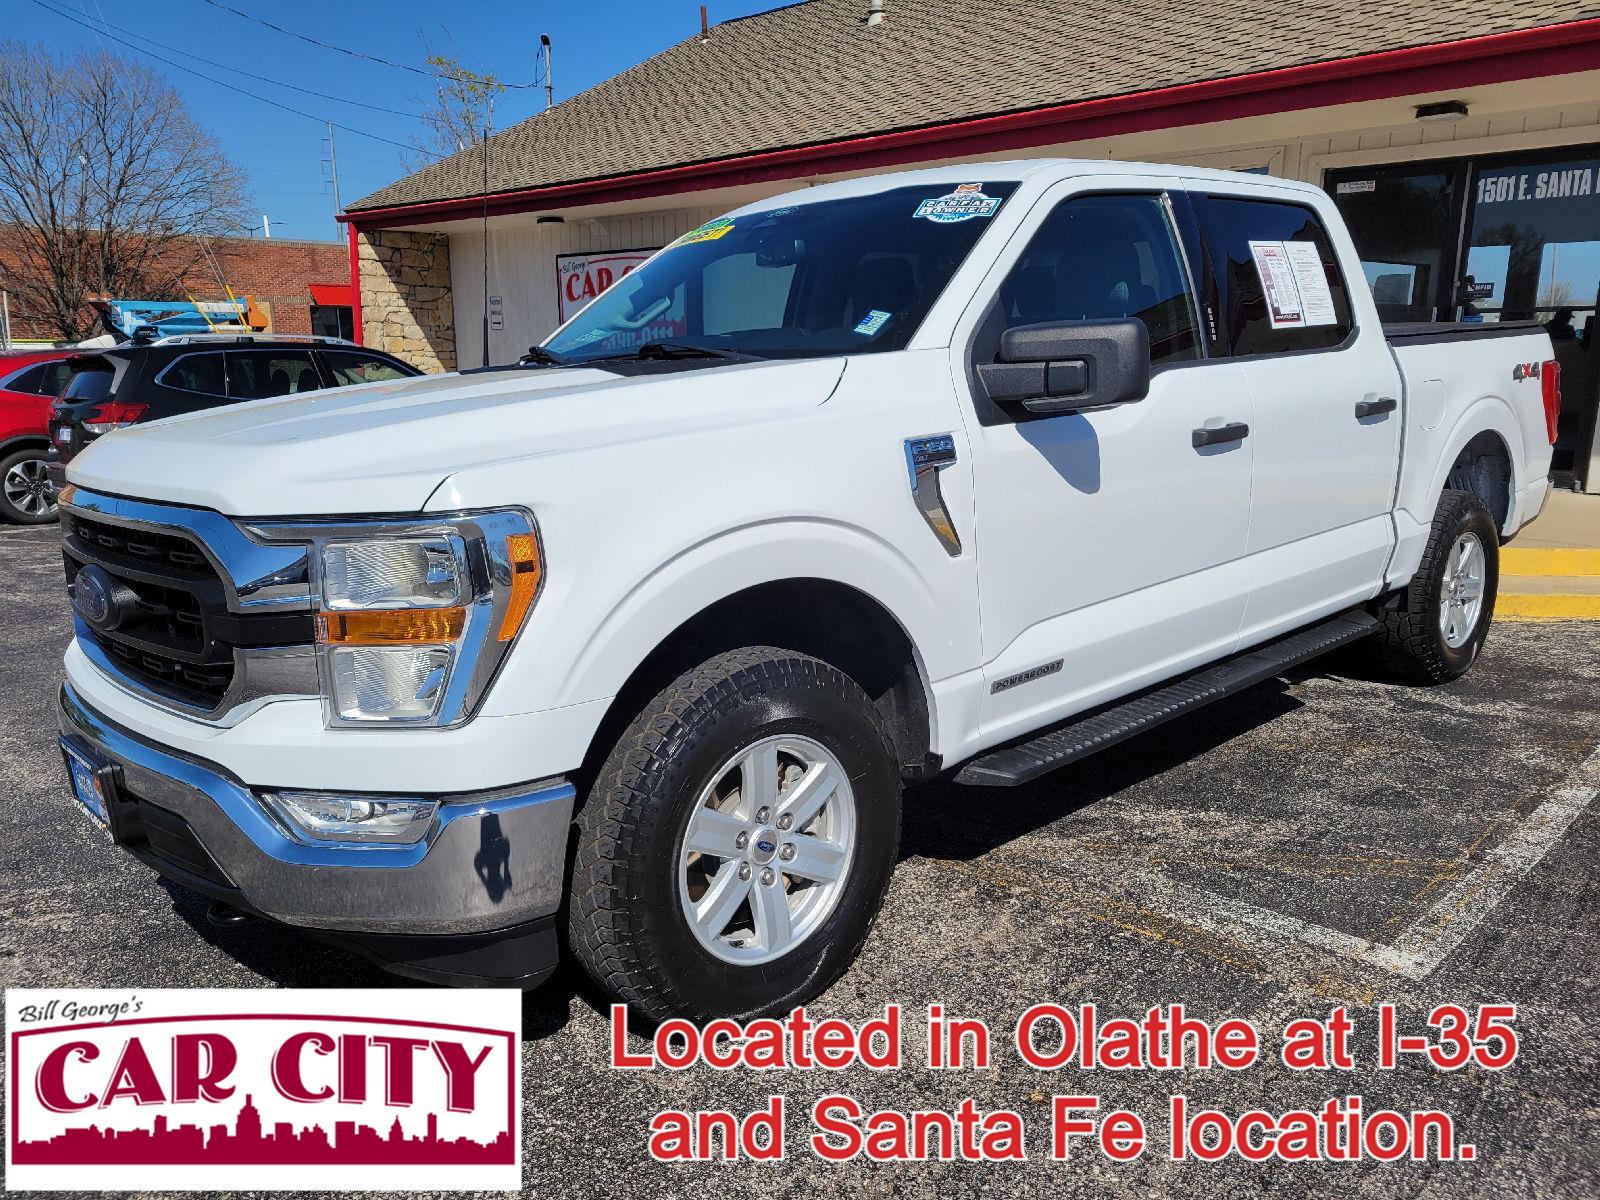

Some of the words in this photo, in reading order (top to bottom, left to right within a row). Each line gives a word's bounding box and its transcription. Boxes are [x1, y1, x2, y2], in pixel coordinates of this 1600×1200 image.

[1478, 176, 1516, 203] 1501
[1518, 174, 1532, 201] E.
[1535, 168, 1592, 199] SANTA
[995, 661, 1062, 690] POWERBOOST
